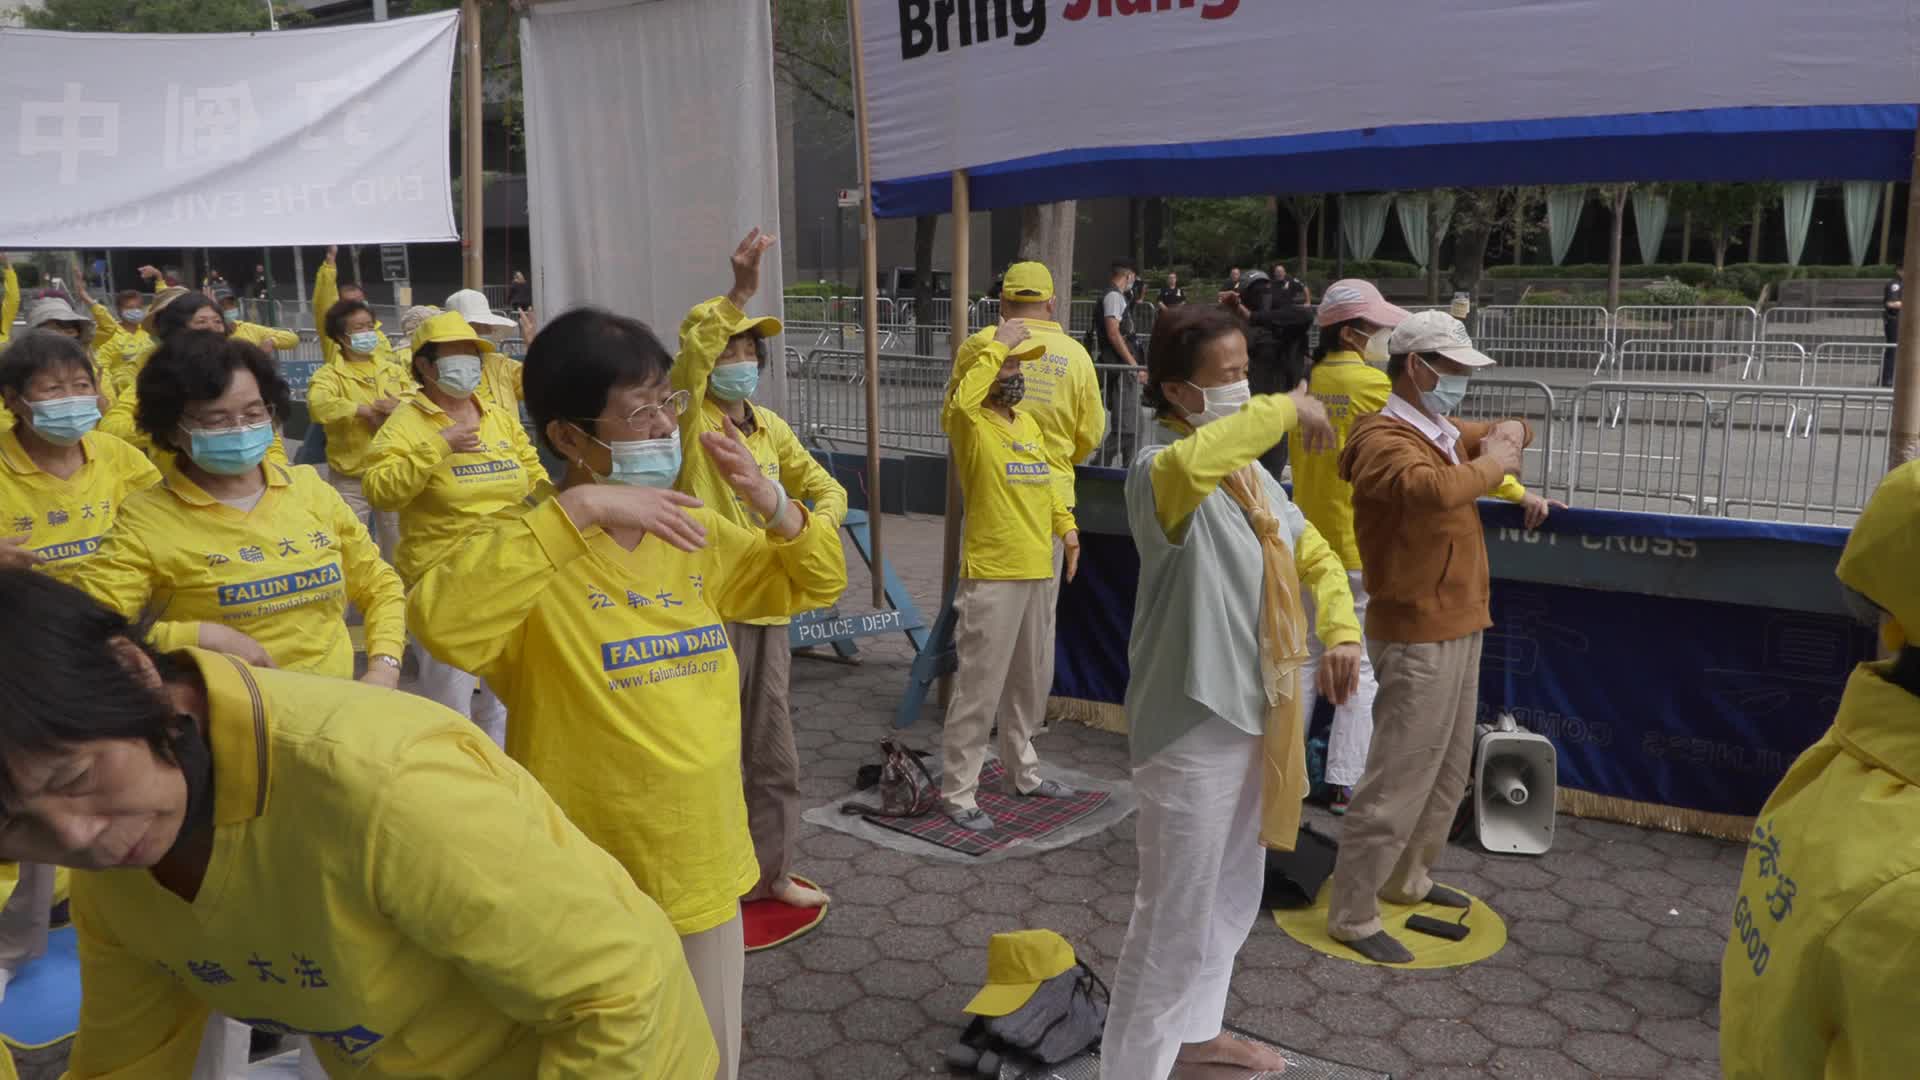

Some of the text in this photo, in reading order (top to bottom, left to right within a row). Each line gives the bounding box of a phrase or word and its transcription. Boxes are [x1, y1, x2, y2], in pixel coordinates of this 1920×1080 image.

[899, 0, 1046, 60] Bring
[38, 543, 81, 560] ALUN
[224, 566, 339, 602] FALUN DAFA
[800, 611, 900, 640] POLICE DEPT
[609, 628, 727, 666] FALUN DAFA
[608, 659, 718, 691] www.falundafa.org
[1735, 896, 1770, 977] GOOD
